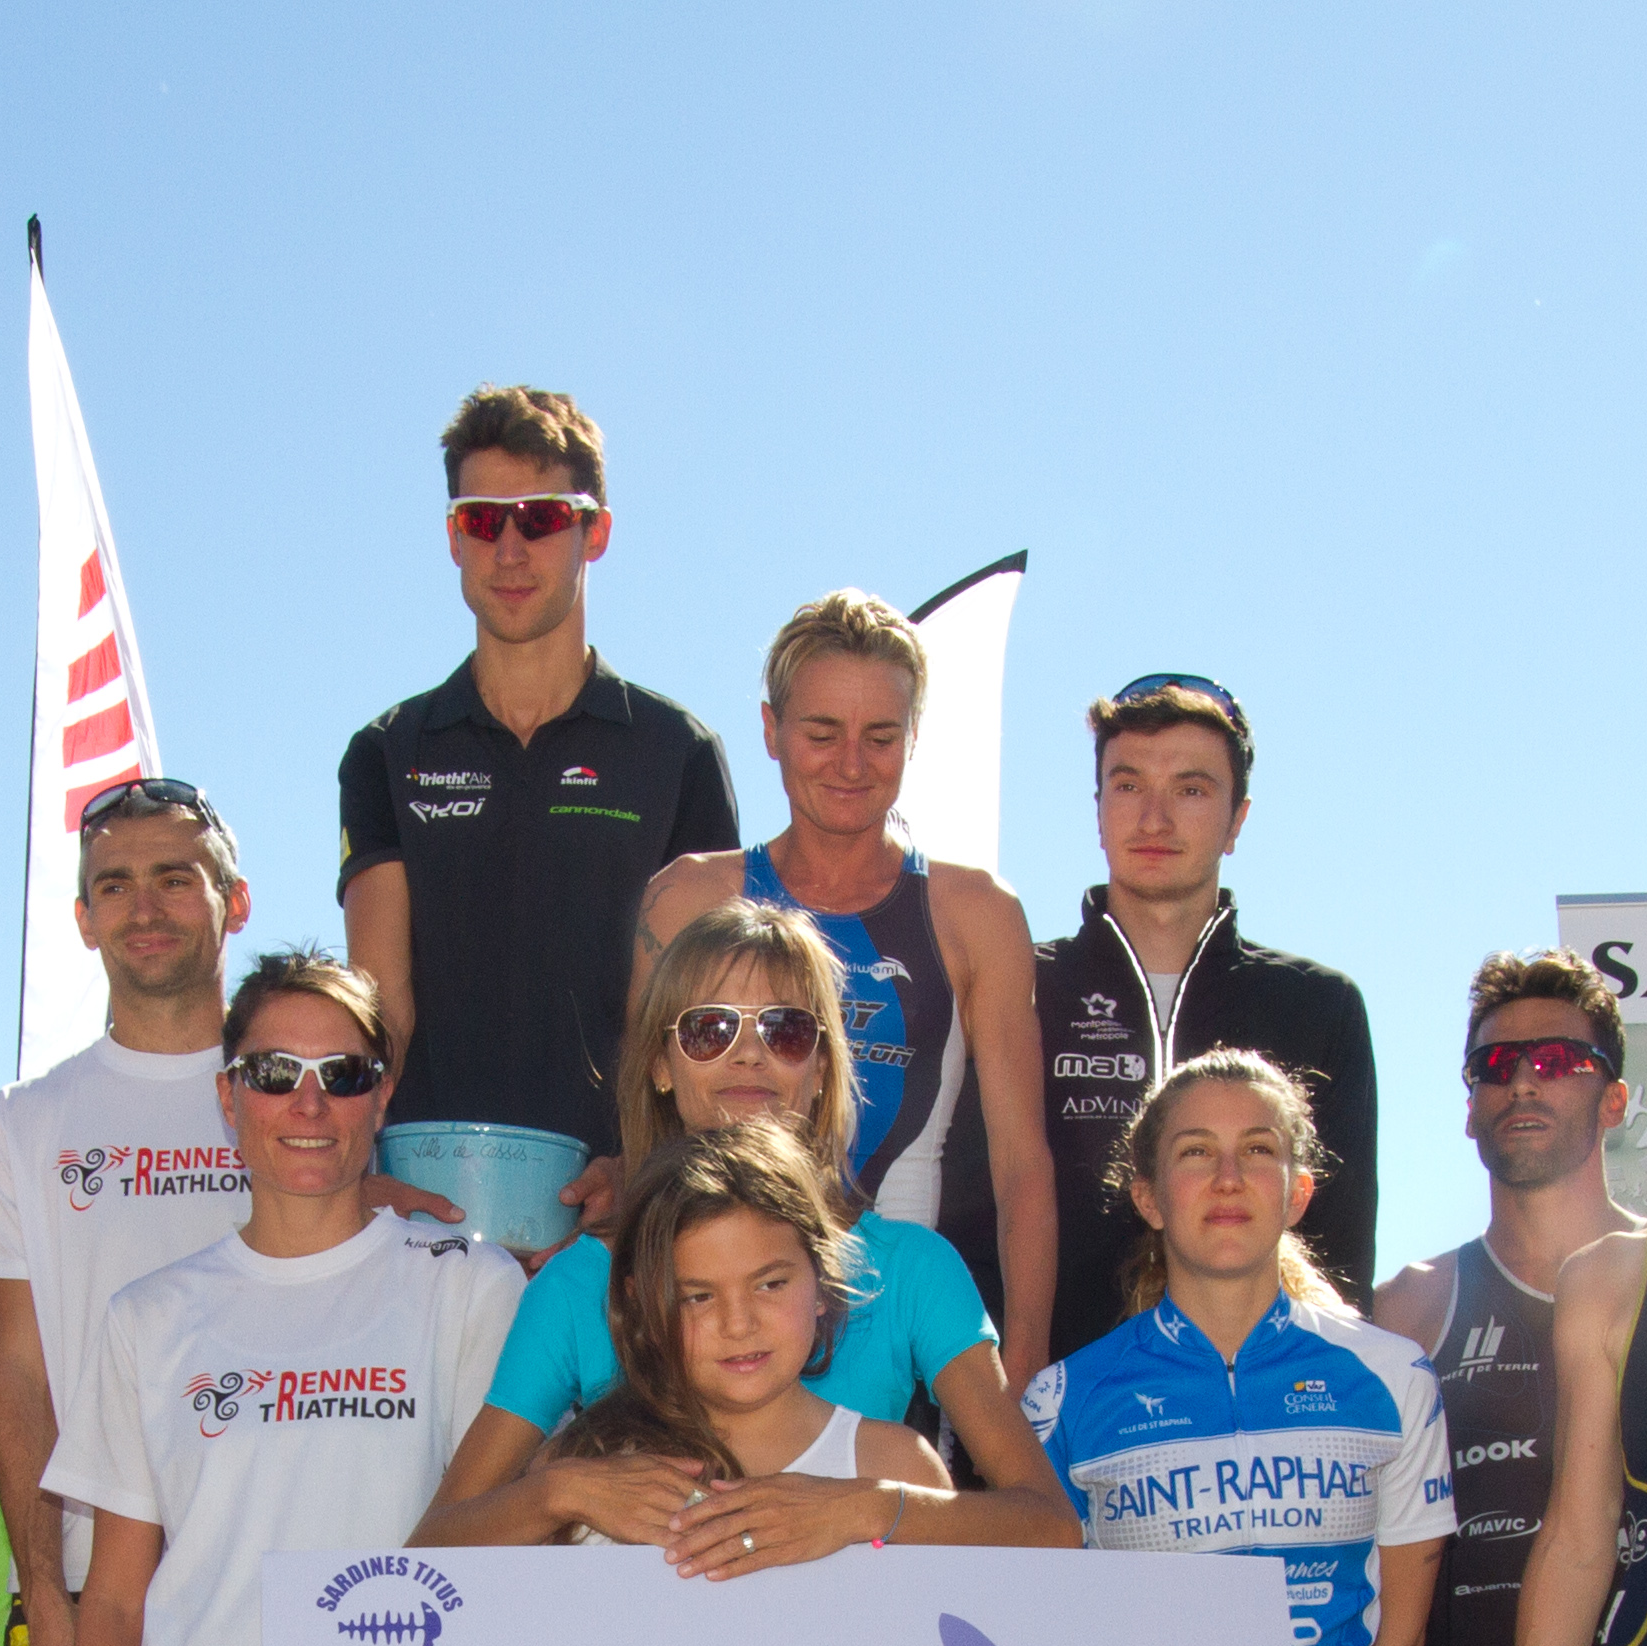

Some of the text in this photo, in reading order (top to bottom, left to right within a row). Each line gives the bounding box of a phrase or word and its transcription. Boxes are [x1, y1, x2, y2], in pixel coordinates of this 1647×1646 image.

[549, 805, 641, 822] cannondale
[452, 1139, 475, 1159] de
[120, 1173, 254, 1197] TRIATHLON
[404, 1236, 466, 1252] kiwami
[1476, 1364, 1492, 1373] DE
[1497, 1362, 1540, 1372] TERRE
[276, 1367, 407, 1421] RENNES
[1283, 1391, 1335, 1407] CONSEIL
[260, 1397, 416, 1423] TRIATHLON
[1119, 1424, 1137, 1435] VILLE
[1138, 1423, 1149, 1431] DE
[1456, 1438, 1538, 1470] LOOK
[1169, 1506, 1323, 1541] TRIATHLON
[1468, 1517, 1526, 1537] MAVIC
[316, 1555, 464, 1613] SARDINES TITUS
